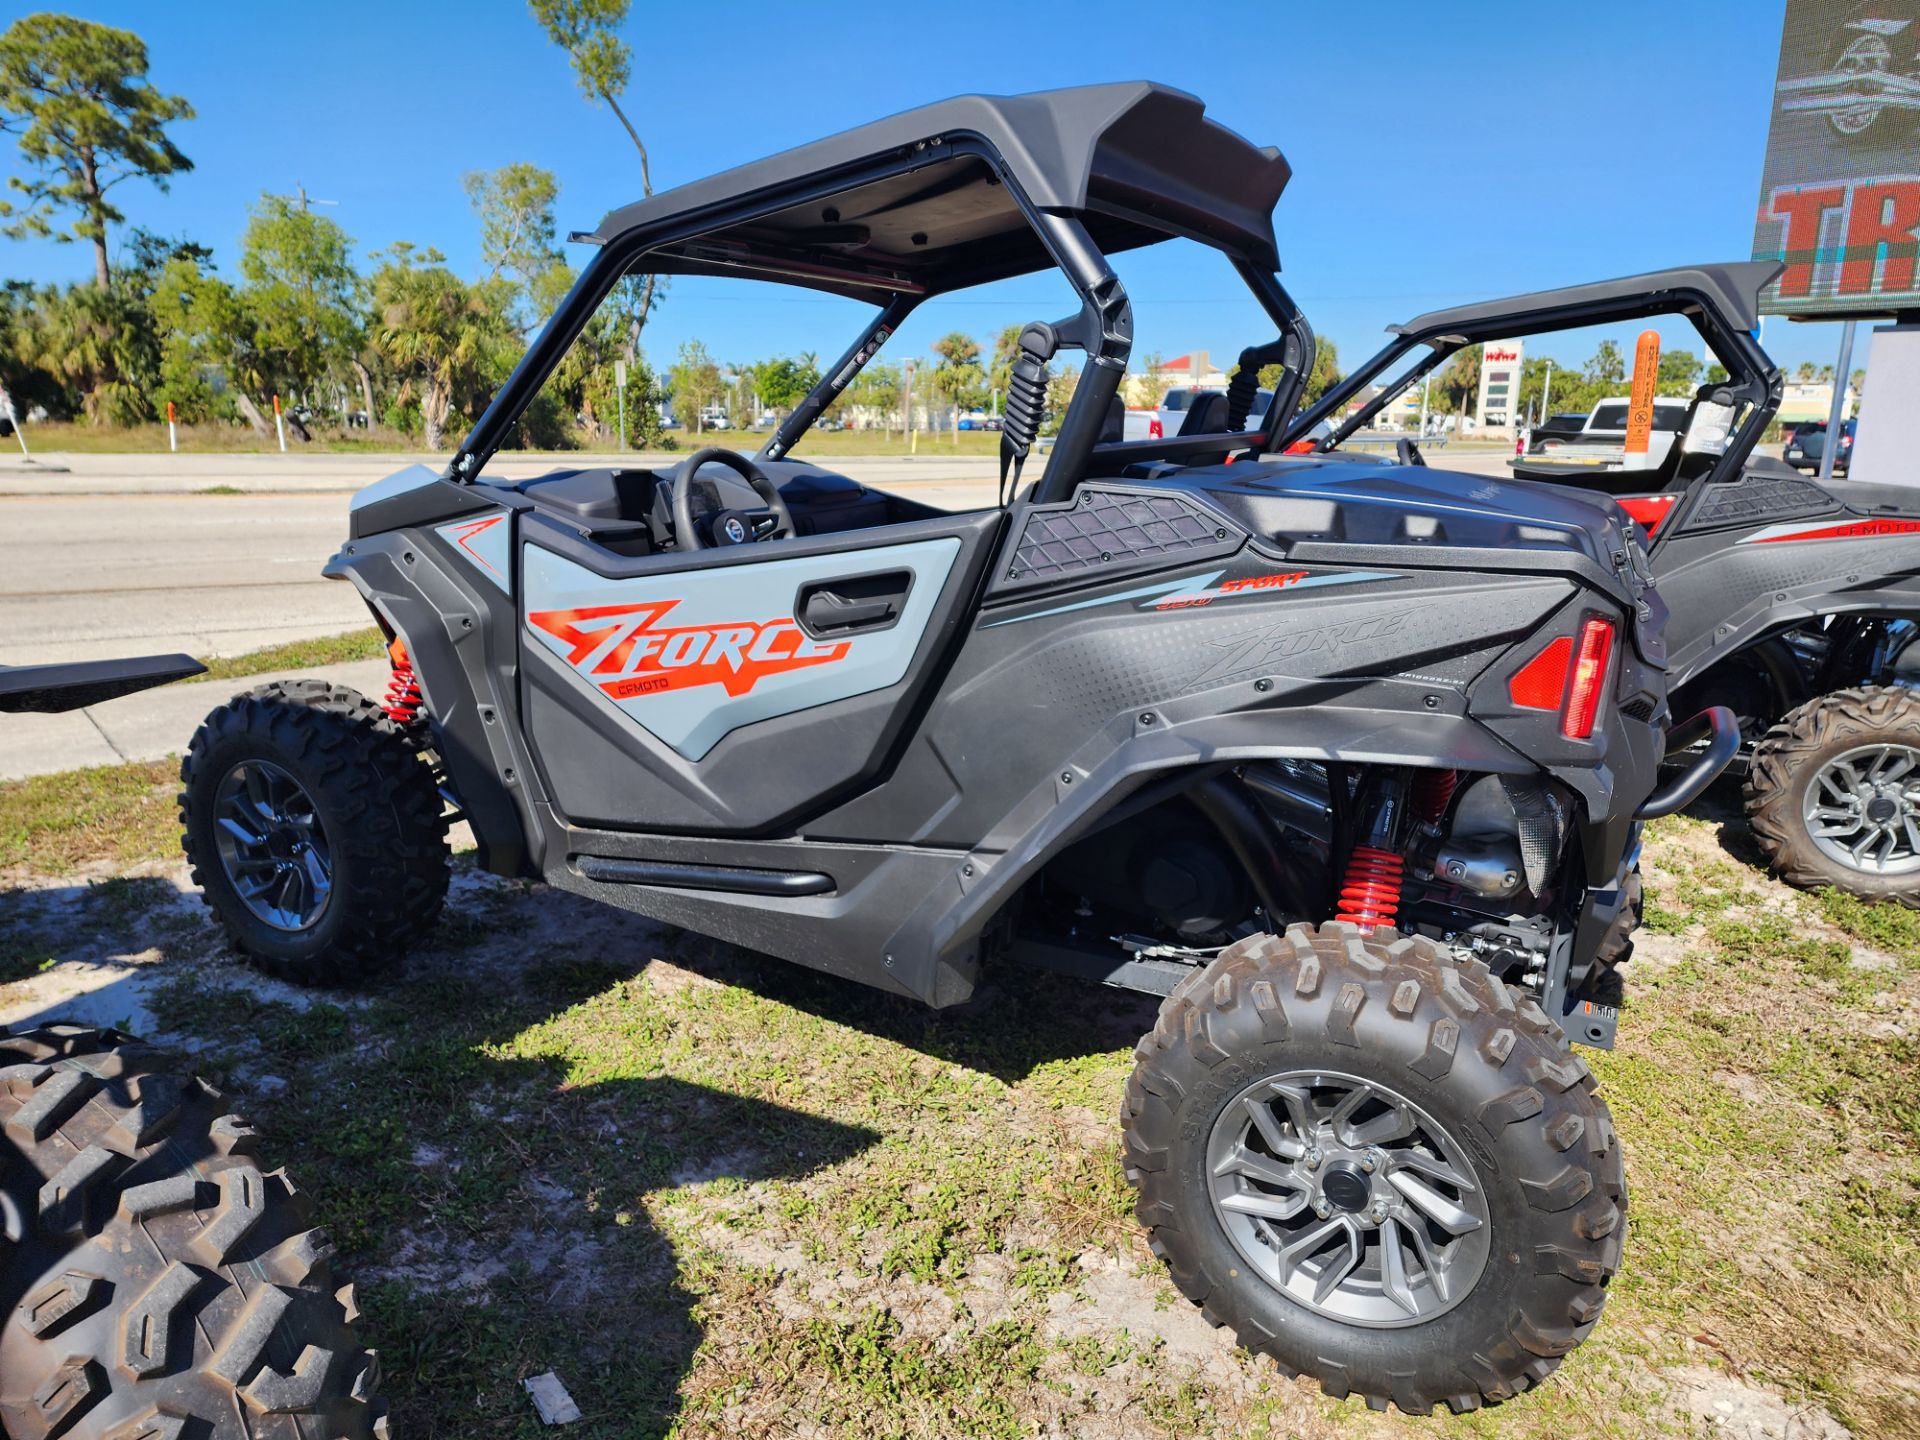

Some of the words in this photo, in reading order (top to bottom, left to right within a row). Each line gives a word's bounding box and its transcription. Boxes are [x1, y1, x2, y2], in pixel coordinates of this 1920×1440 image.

[1836, 523, 1918, 536] CFMOTO
[1218, 570, 1311, 594] SPORT
[617, 678, 669, 695] CFMOTO
